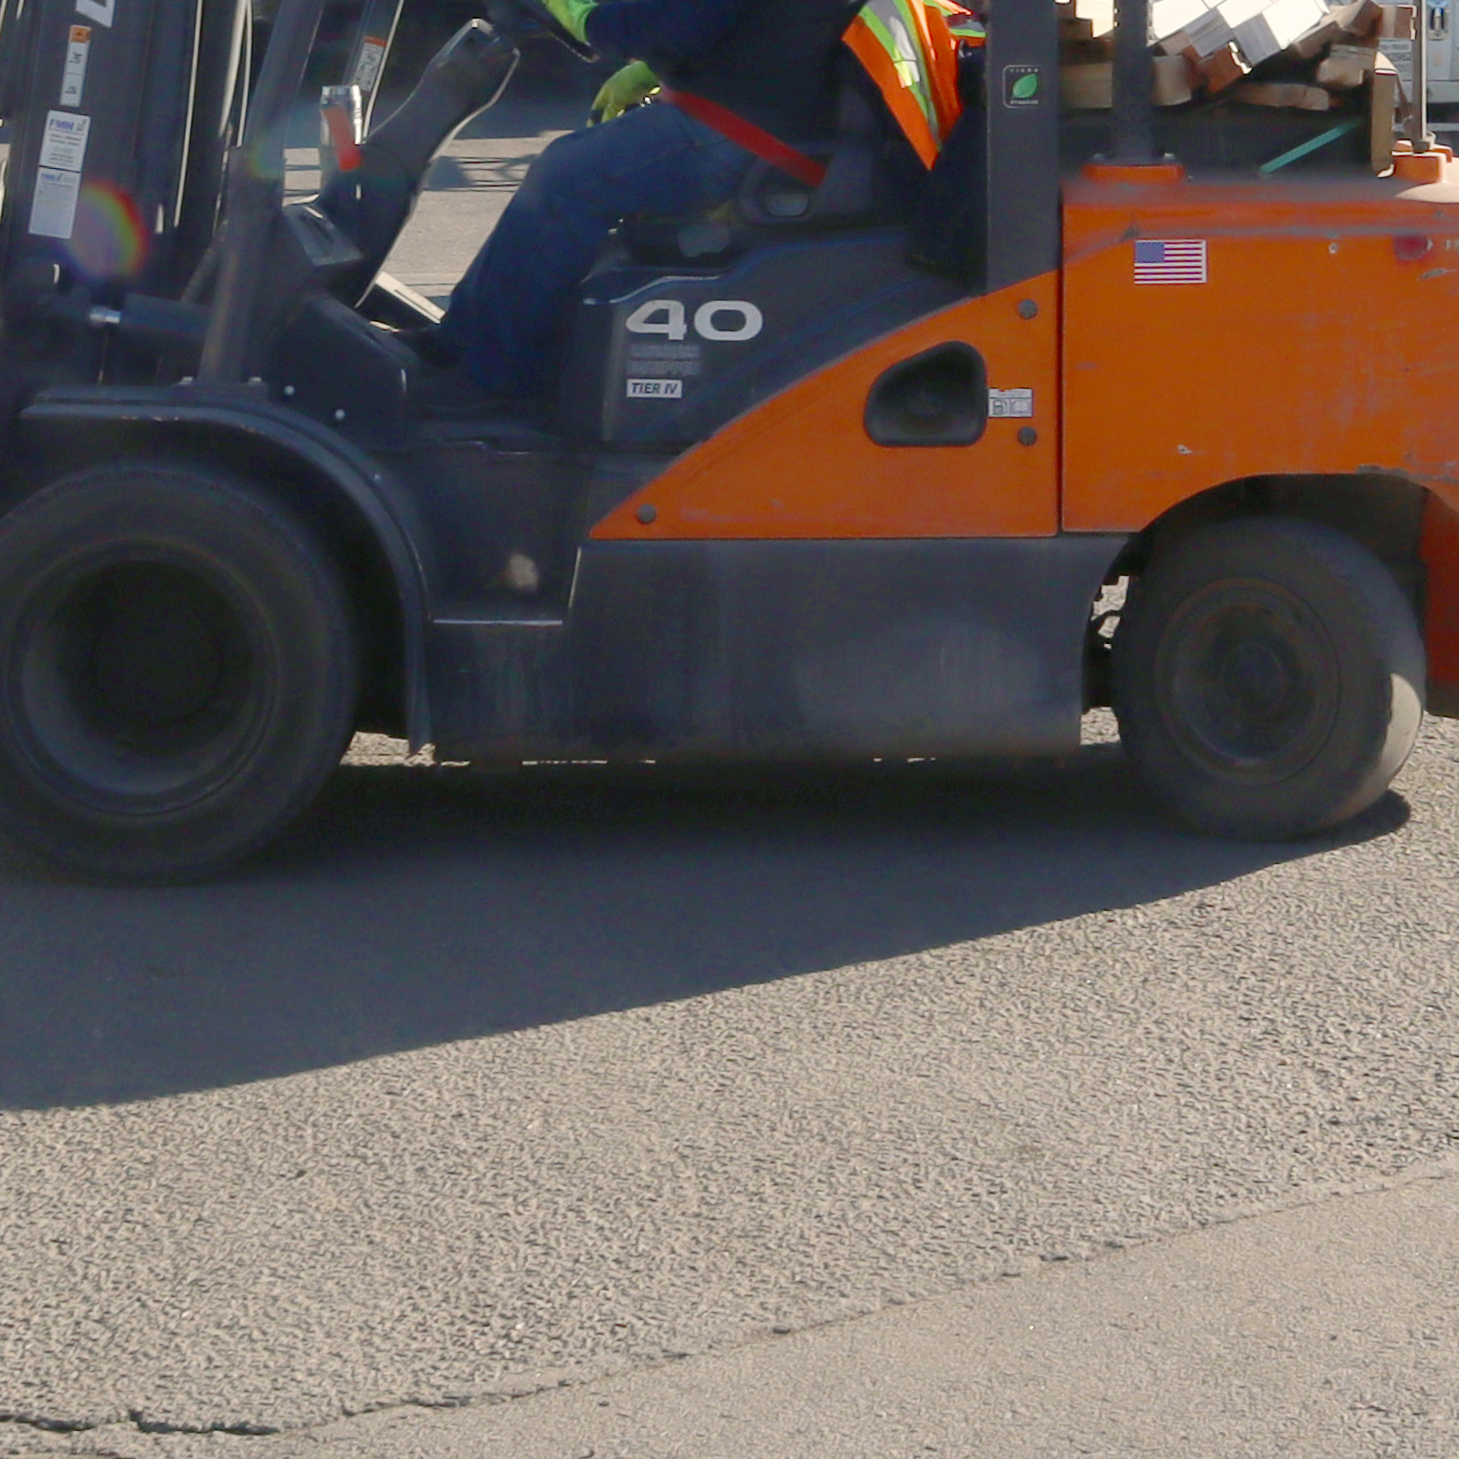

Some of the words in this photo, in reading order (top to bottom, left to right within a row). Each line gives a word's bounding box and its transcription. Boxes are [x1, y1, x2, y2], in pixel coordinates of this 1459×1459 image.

[625, 299, 763, 341] 40
[631, 383, 660, 394] TIER
[664, 383, 678, 394] IV
